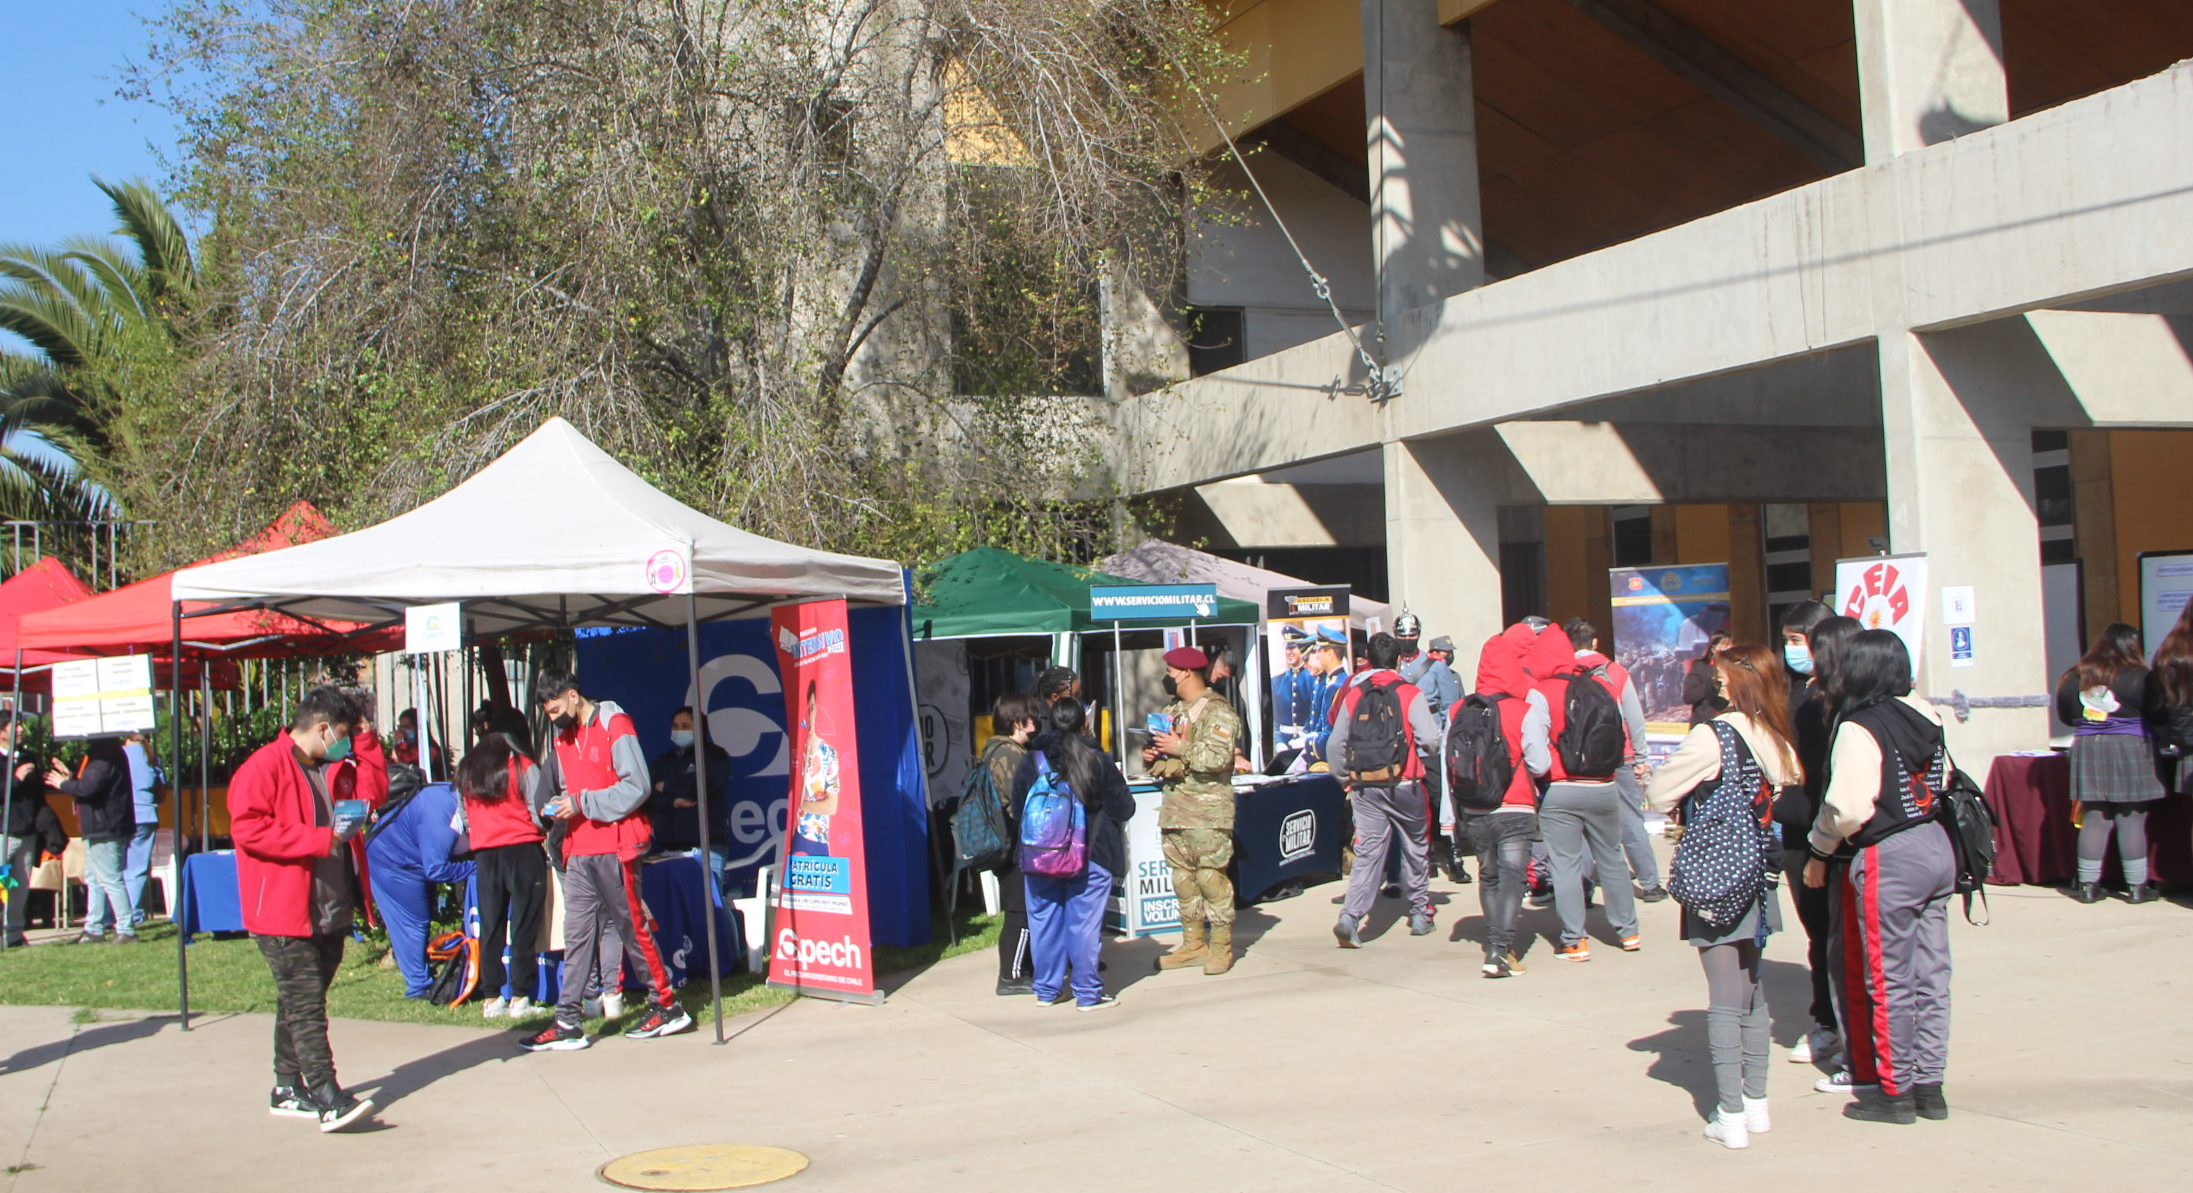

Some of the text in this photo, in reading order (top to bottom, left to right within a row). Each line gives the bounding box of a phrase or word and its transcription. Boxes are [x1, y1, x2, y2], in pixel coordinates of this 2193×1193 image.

[1092, 594, 1215, 607] WWW.SERVICIOMILITAR.CL
[1297, 602, 1331, 612] MILITAR
[1285, 814, 1311, 836] SERVICIO
[1285, 829, 1311, 853] MILITAR
[790, 873, 832, 887] GRATIS
